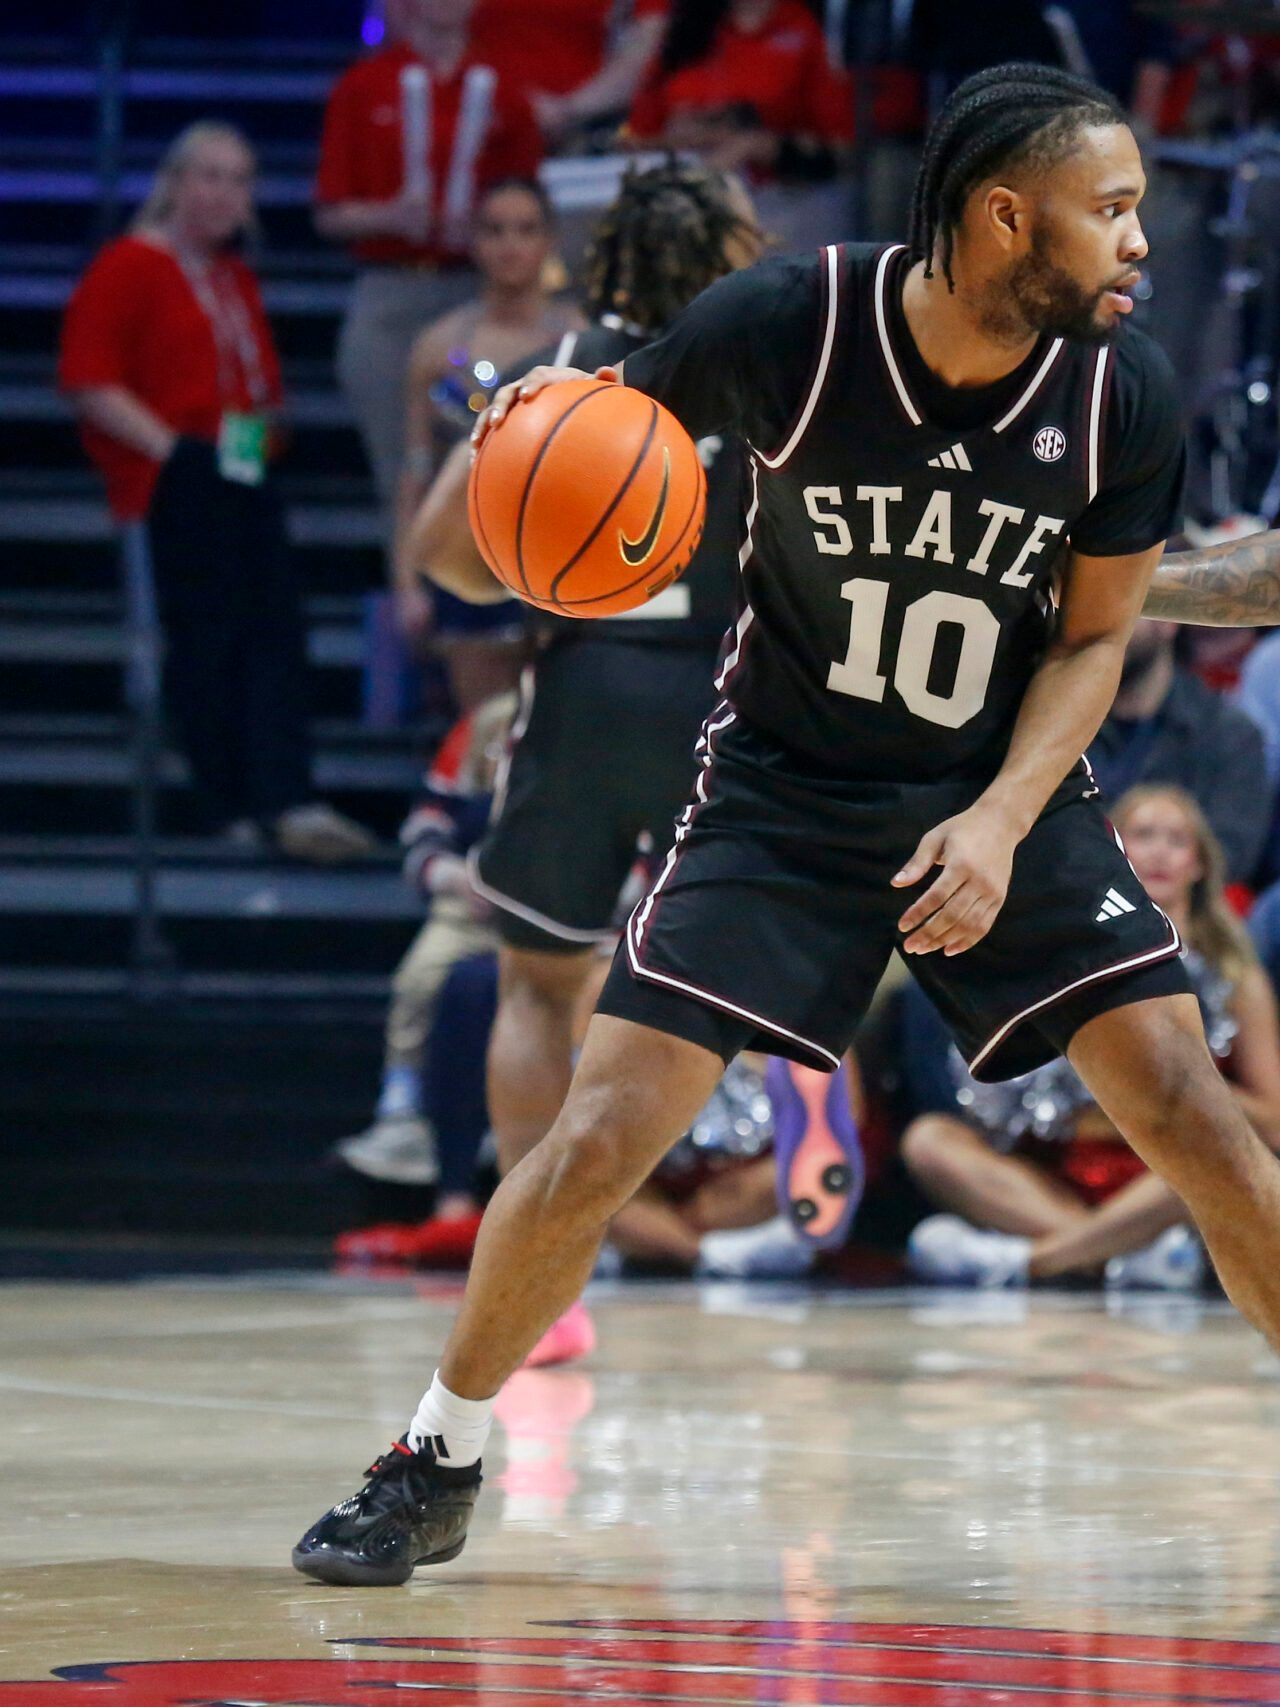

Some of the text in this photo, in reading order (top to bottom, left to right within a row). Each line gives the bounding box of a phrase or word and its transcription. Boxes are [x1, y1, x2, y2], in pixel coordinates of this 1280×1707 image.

[1035, 429, 1063, 459] SEC
[802, 485, 1066, 589] STATE
[826, 577, 1001, 729] 10
